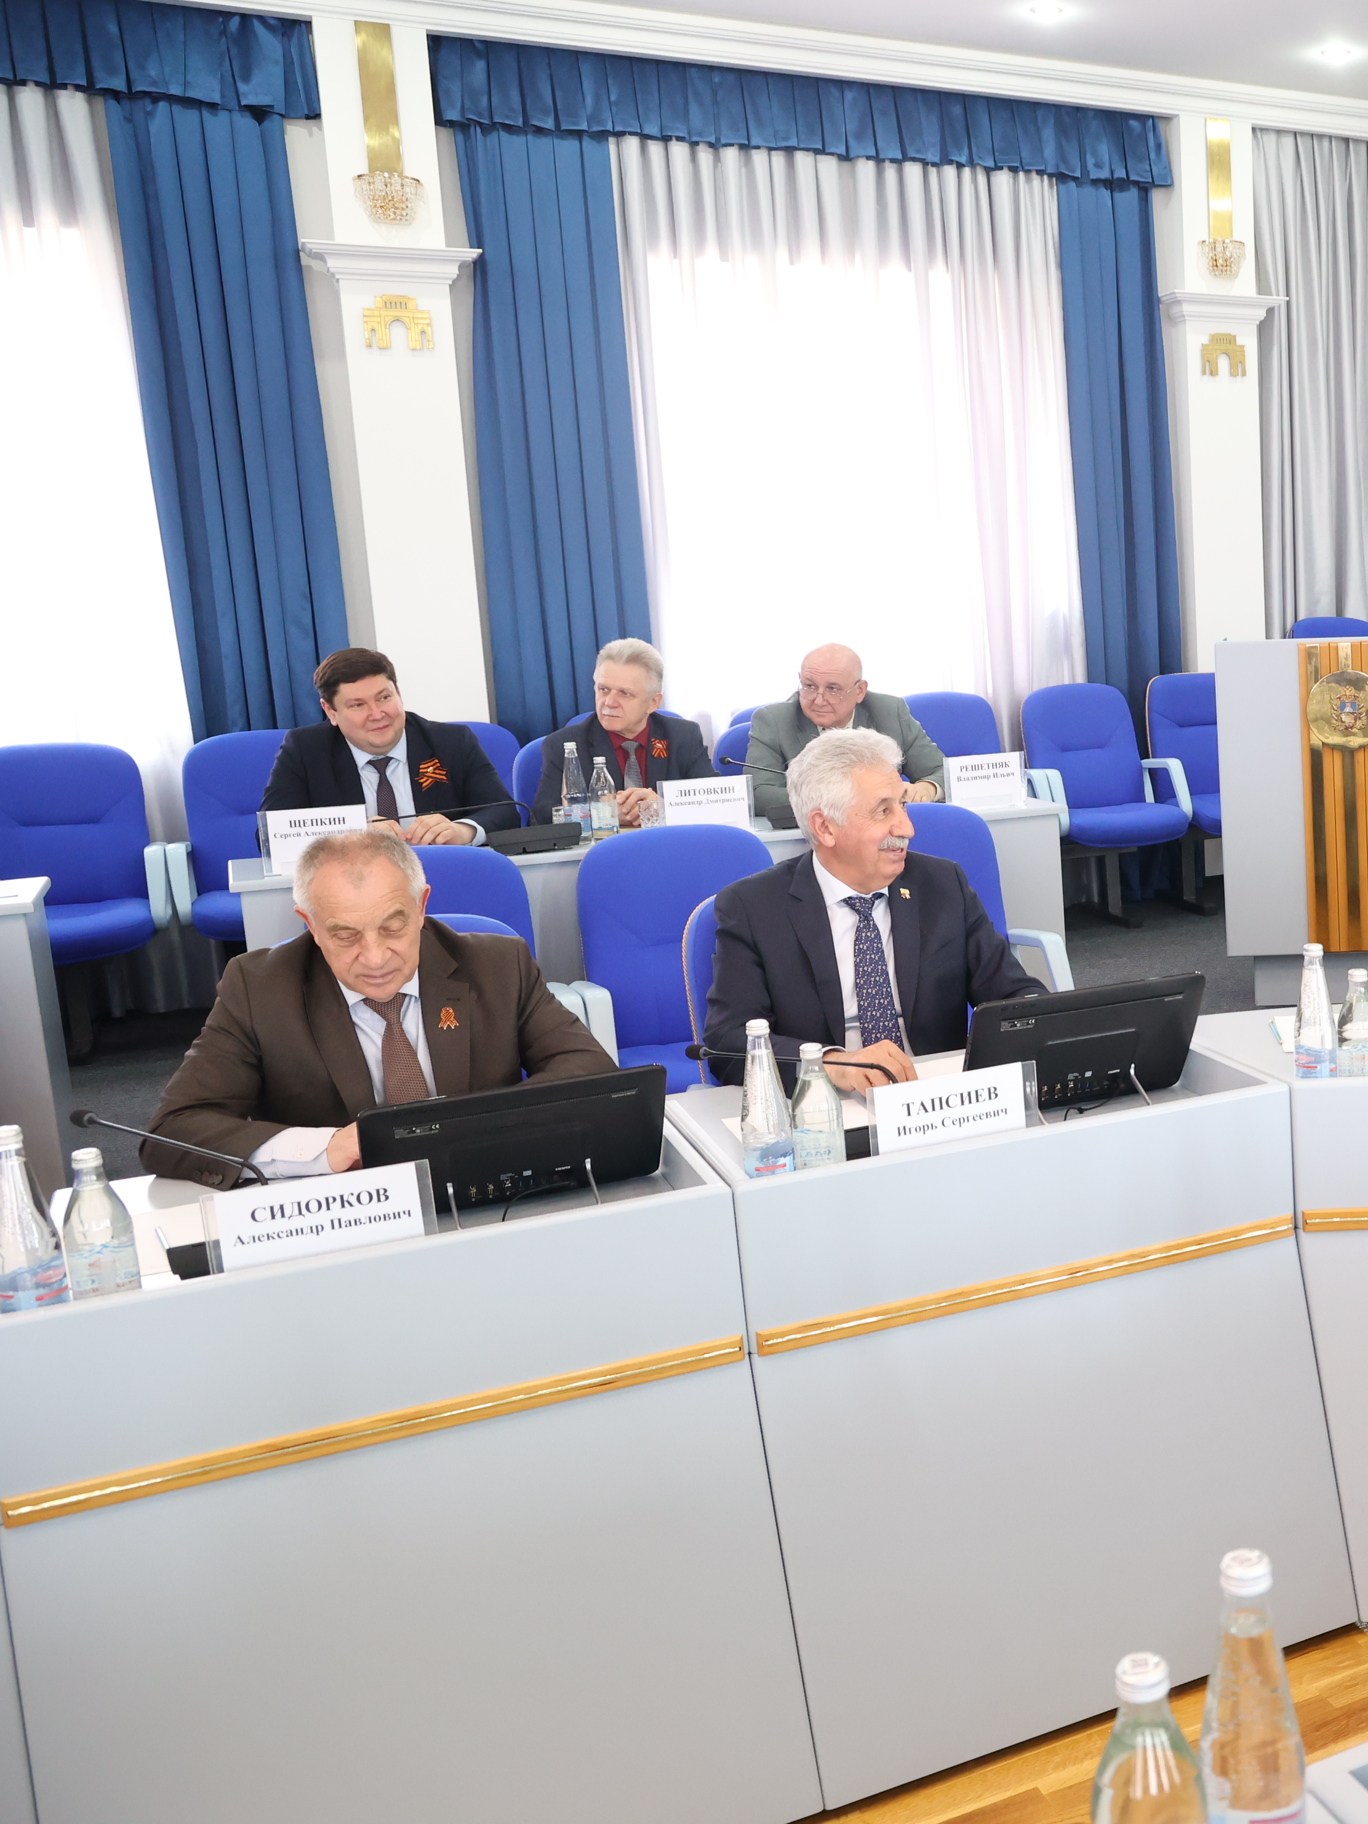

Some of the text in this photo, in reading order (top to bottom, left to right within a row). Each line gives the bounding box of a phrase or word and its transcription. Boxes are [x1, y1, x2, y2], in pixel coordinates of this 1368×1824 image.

[959, 761, 1011, 773] РЕШЕТНЯК
[956, 771, 1015, 782] Владимир Ильич
[675, 786, 736, 798] ЛИТОВКИН
[667, 797, 746, 808] Александр Дмитриевич
[289, 816, 346, 829] ЩЕПКИН
[273, 830, 302, 840] Сергей
[901, 1086, 999, 1117] ТАПСИЕВ
[897, 1107, 1008, 1137] Игорь Сергеевич
[250, 1187, 390, 1223] СИДОРКОВ
[233, 1209, 412, 1247] Александр Павлович
